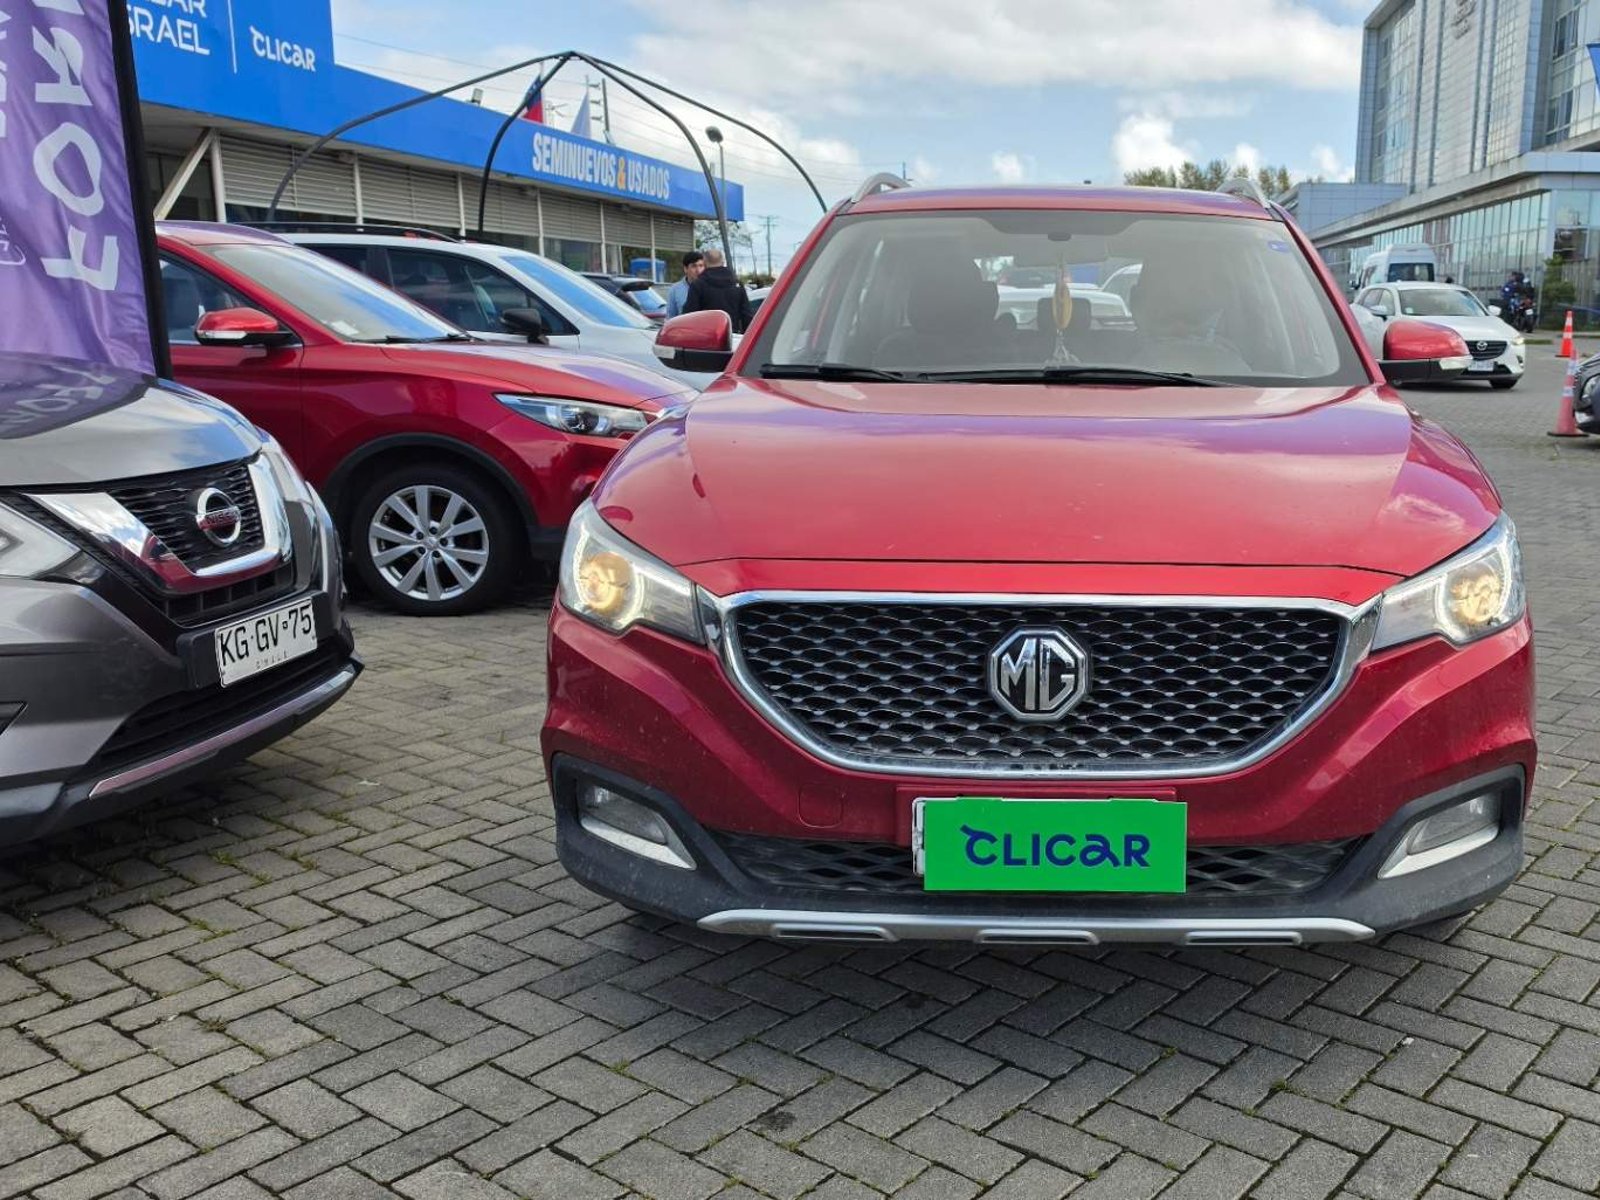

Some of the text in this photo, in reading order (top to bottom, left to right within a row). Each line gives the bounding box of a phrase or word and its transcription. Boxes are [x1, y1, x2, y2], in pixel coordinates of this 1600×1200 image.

[532, 132, 617, 188] SEMINUEVOS
[628, 161, 670, 199] USADOS
[1001, 638, 1075, 711] MG
